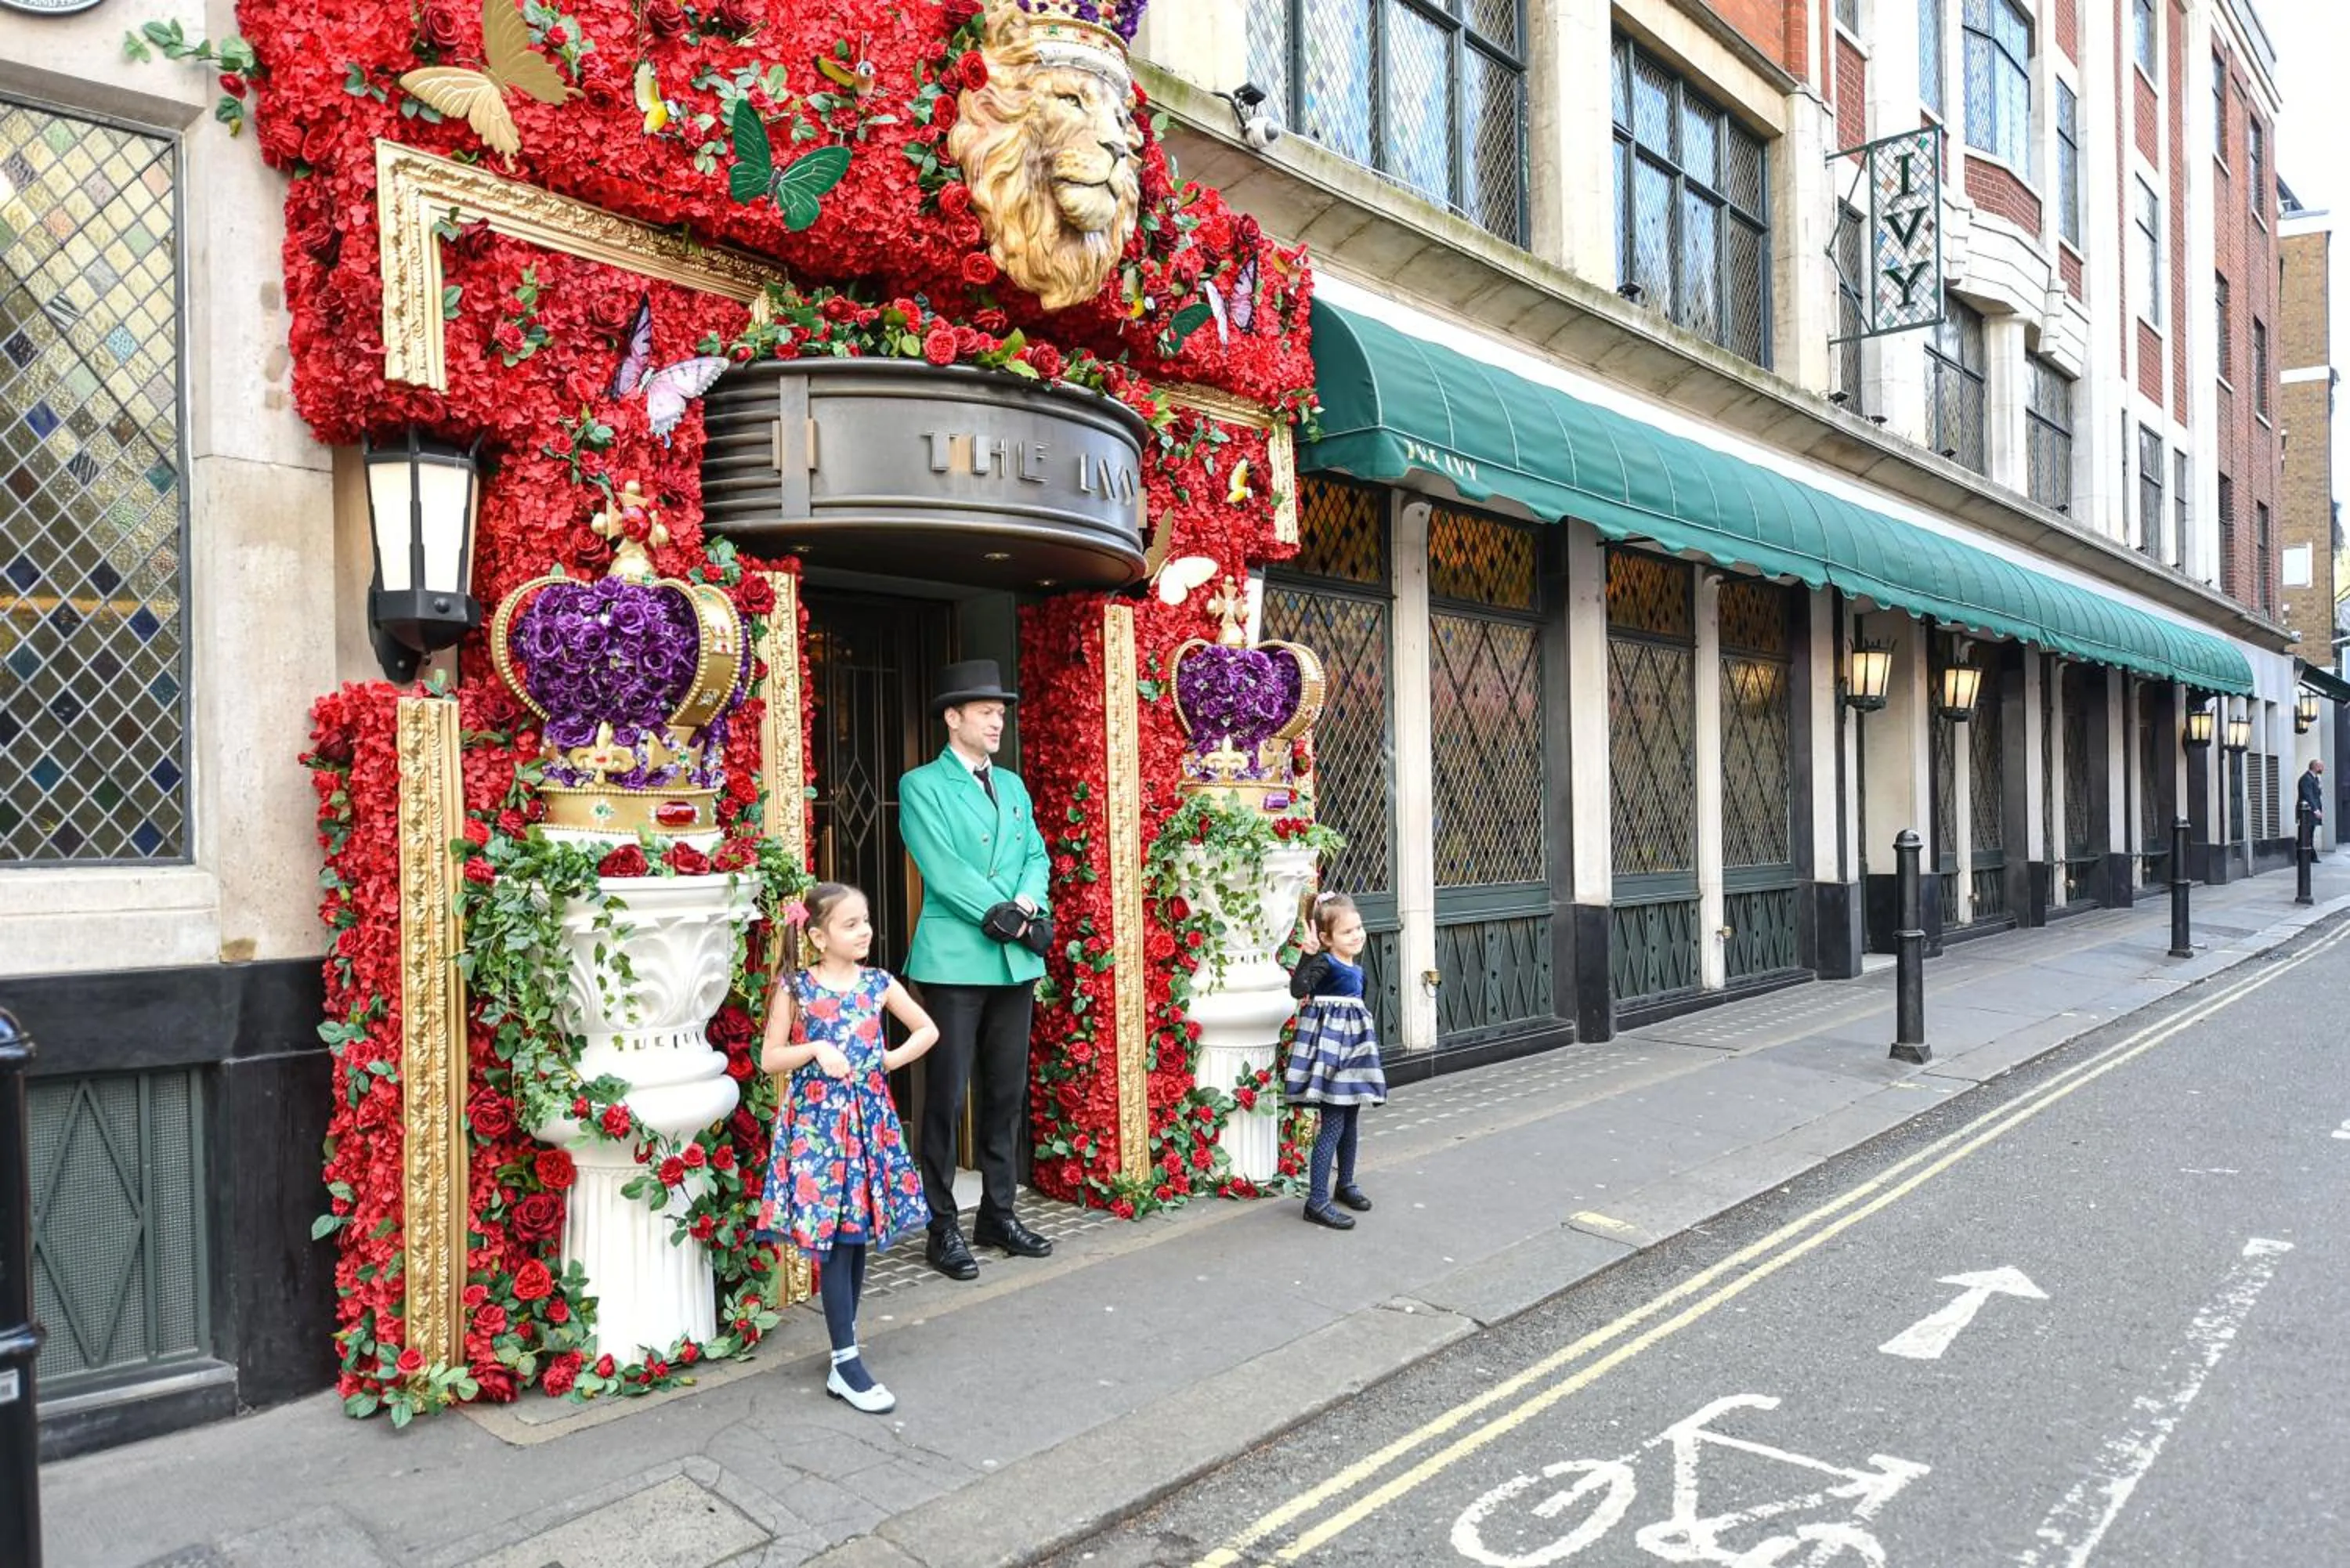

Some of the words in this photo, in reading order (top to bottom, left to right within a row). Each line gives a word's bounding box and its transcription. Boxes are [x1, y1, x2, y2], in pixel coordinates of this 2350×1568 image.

[1881, 152, 1929, 309] IVY
[920, 431, 1050, 484] THE
[1444, 453, 1477, 482] IVY
